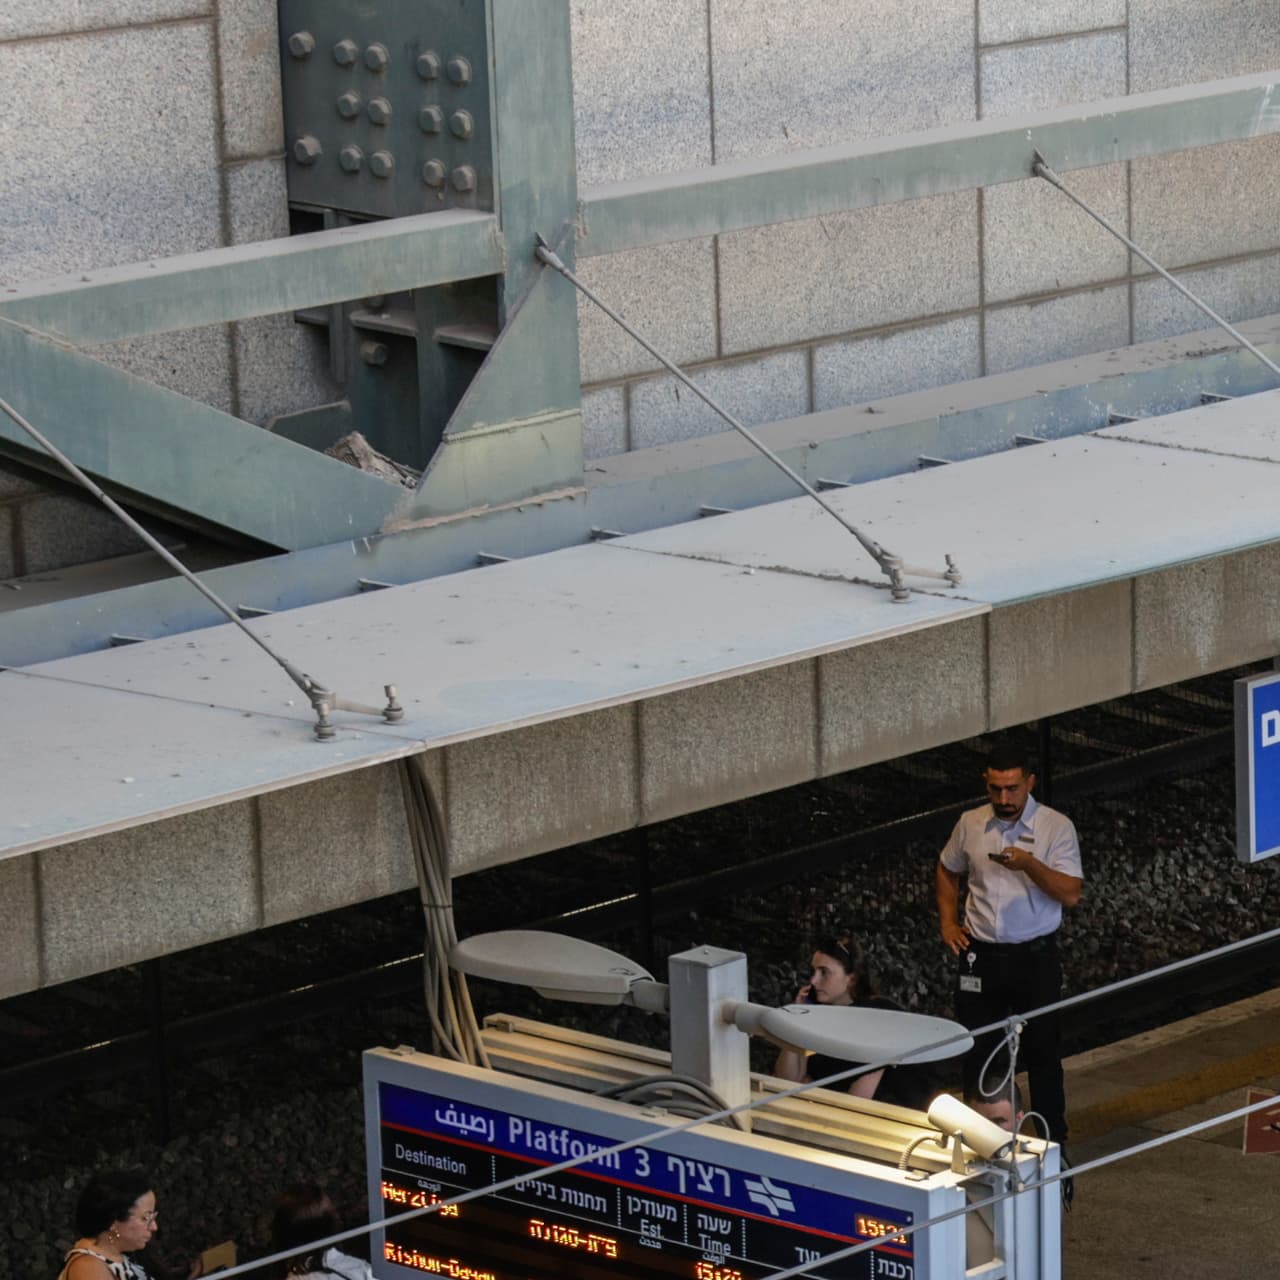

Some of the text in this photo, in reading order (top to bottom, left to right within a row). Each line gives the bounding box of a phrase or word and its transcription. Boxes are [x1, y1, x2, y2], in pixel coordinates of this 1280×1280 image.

[435, 1104, 495, 1142] رصيف
[395, 1143, 466, 1175] Destination
[509, 1116, 651, 1178] Platform 3
[667, 1156, 732, 1198] רציף
[515, 1176, 607, 1213] תחנות ביניים
[626, 1195, 678, 1222] מעודכן
[640, 1219, 664, 1240] Est.
[698, 1213, 731, 1235] שעה
[699, 1233, 731, 1256] Time
[878, 1258, 913, 1280] רכבת
